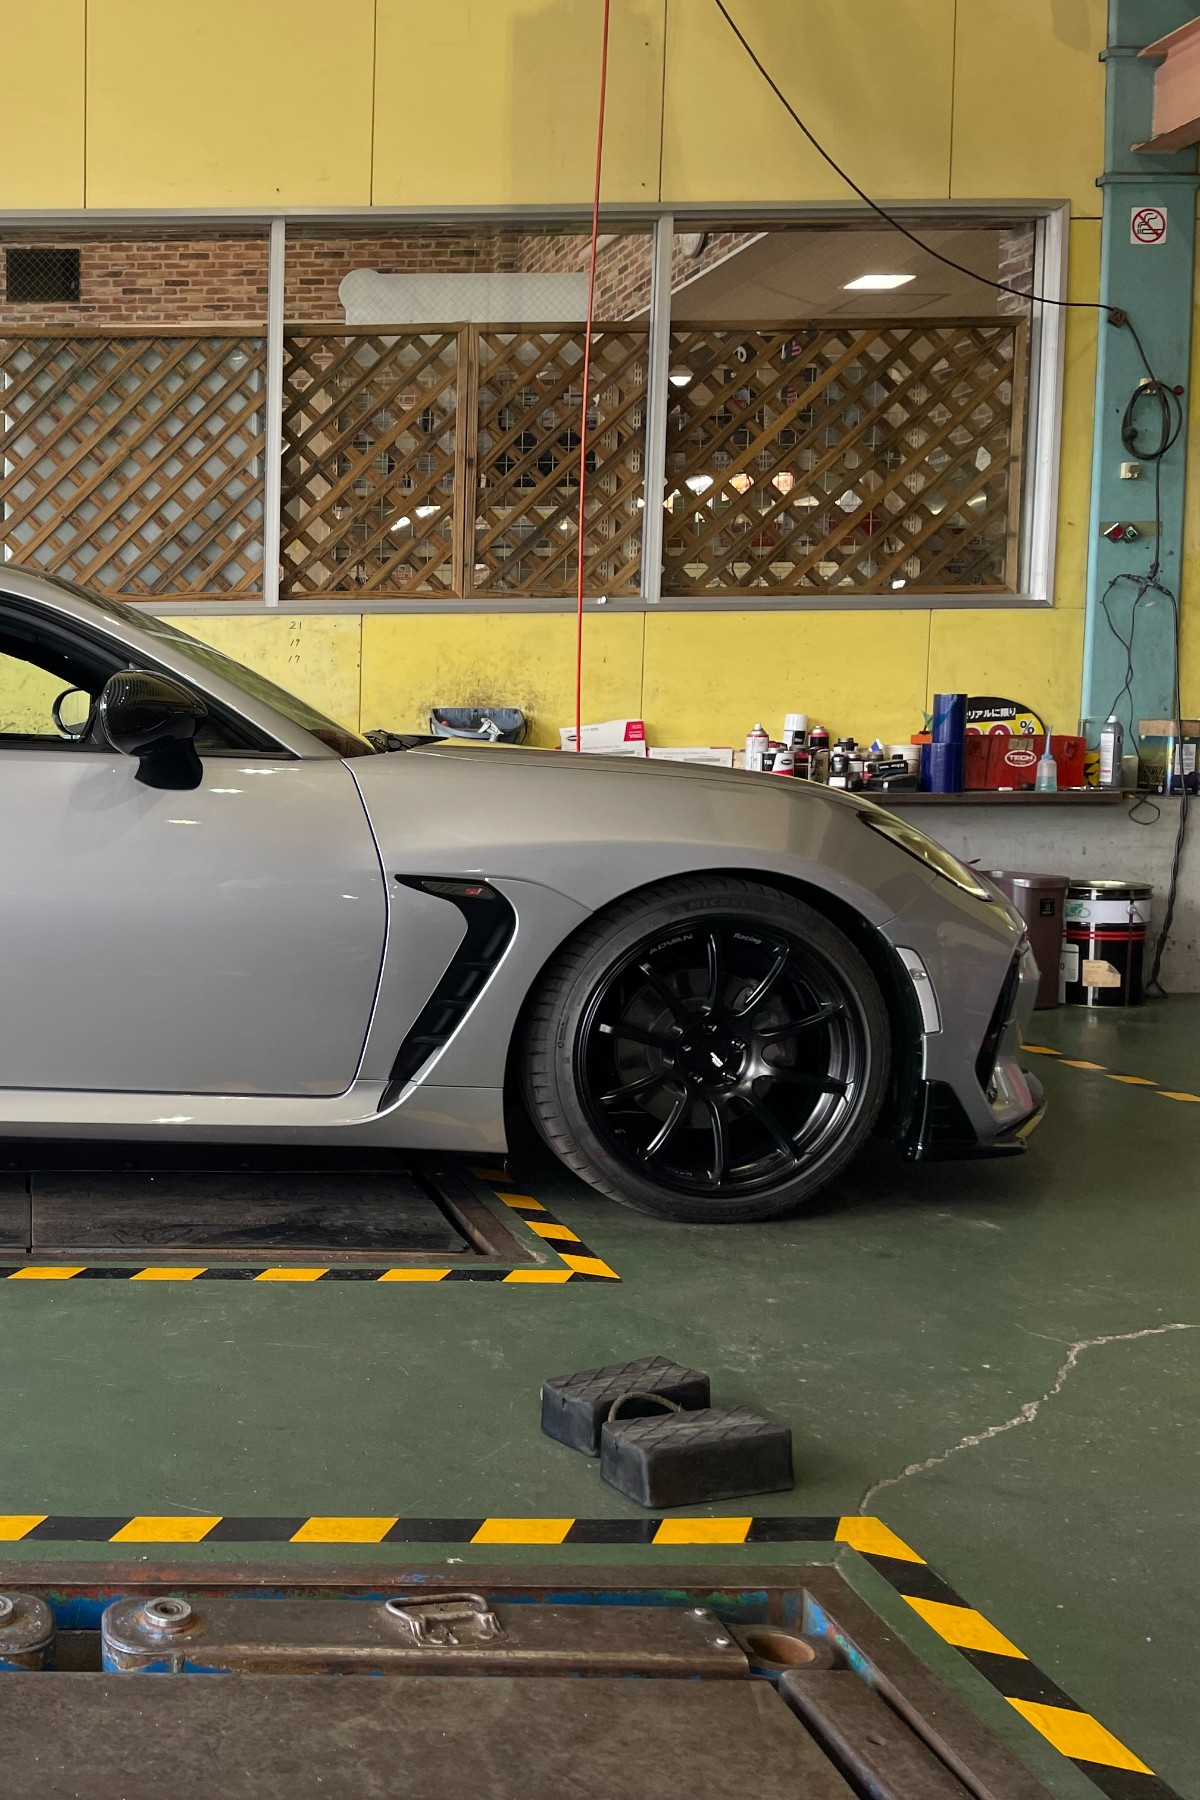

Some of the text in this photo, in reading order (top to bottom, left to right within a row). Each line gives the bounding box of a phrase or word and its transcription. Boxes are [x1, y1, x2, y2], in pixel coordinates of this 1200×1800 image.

[289, 621, 301, 630] 21
[649, 932, 763, 956] ADVAN Racing
